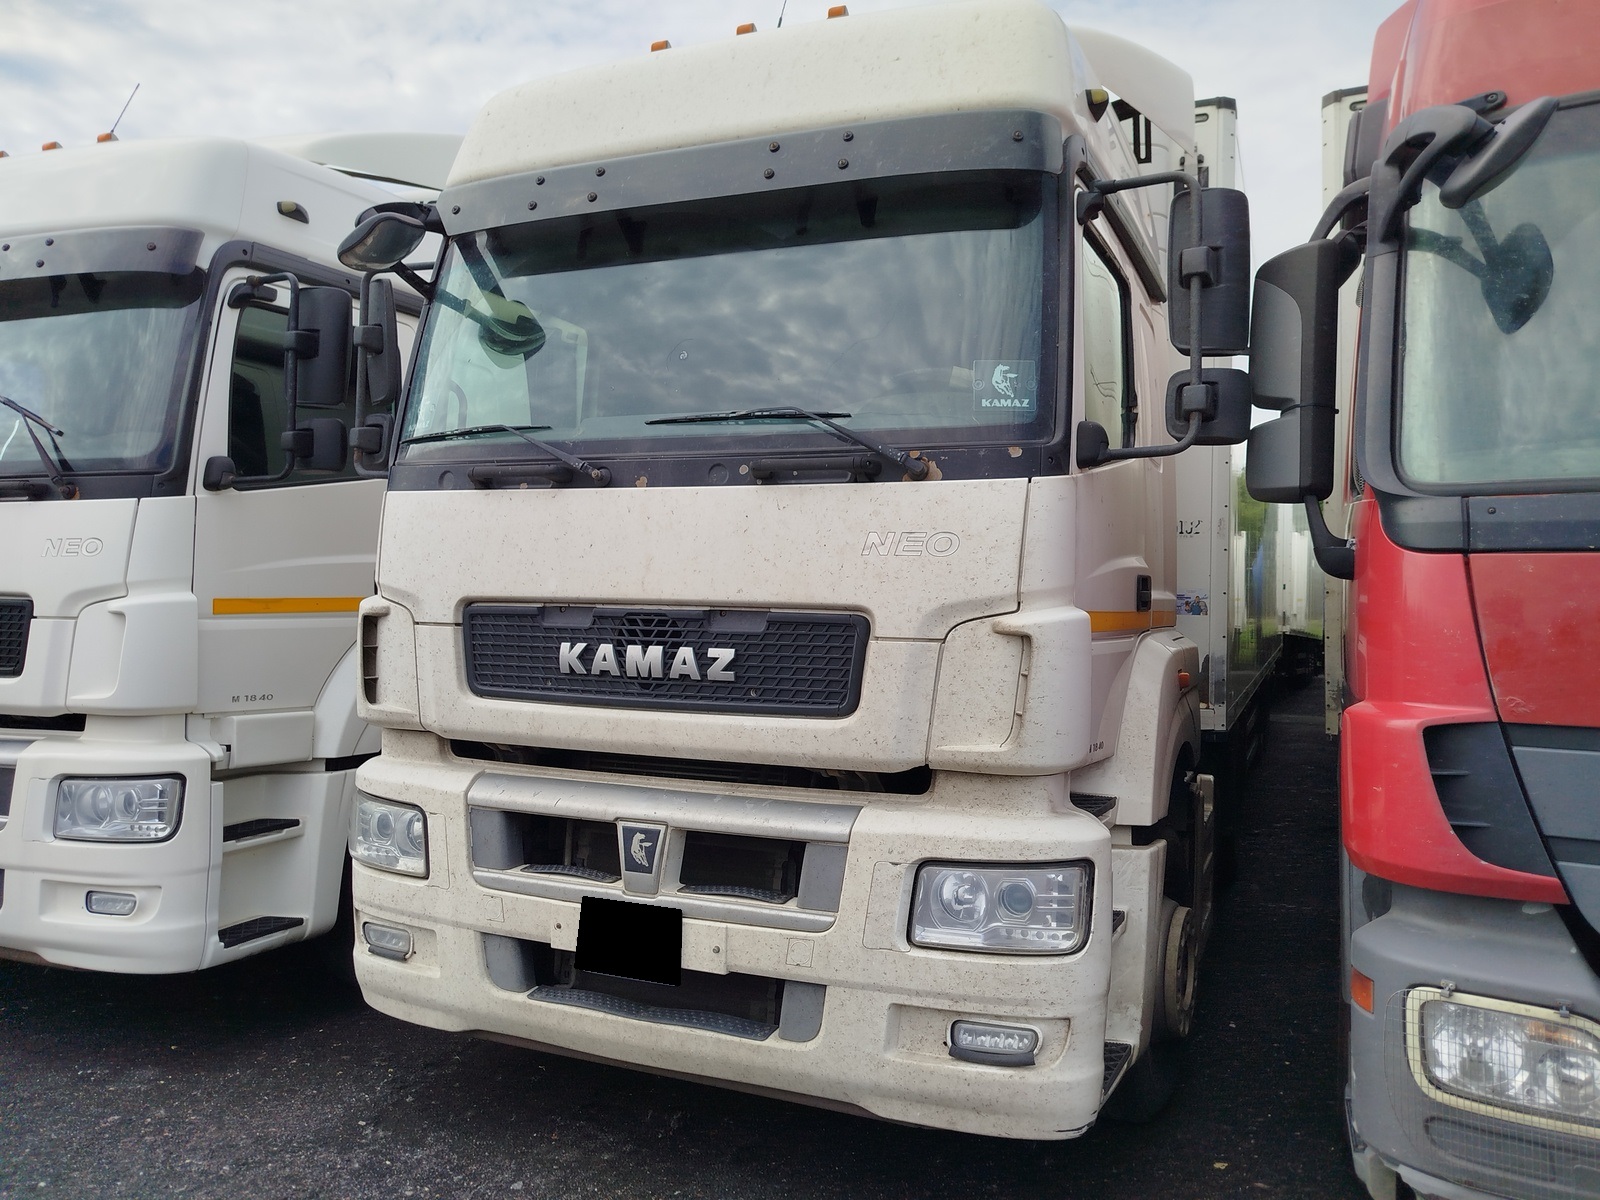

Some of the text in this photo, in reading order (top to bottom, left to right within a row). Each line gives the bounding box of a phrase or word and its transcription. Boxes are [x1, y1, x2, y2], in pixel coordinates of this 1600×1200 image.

[981, 398, 1030, 407] KAMAZ
[40, 536, 104, 558] NEO
[860, 531, 961, 558] NEO
[559, 642, 736, 682] KAMAZ
[231, 695, 240, 703] M
